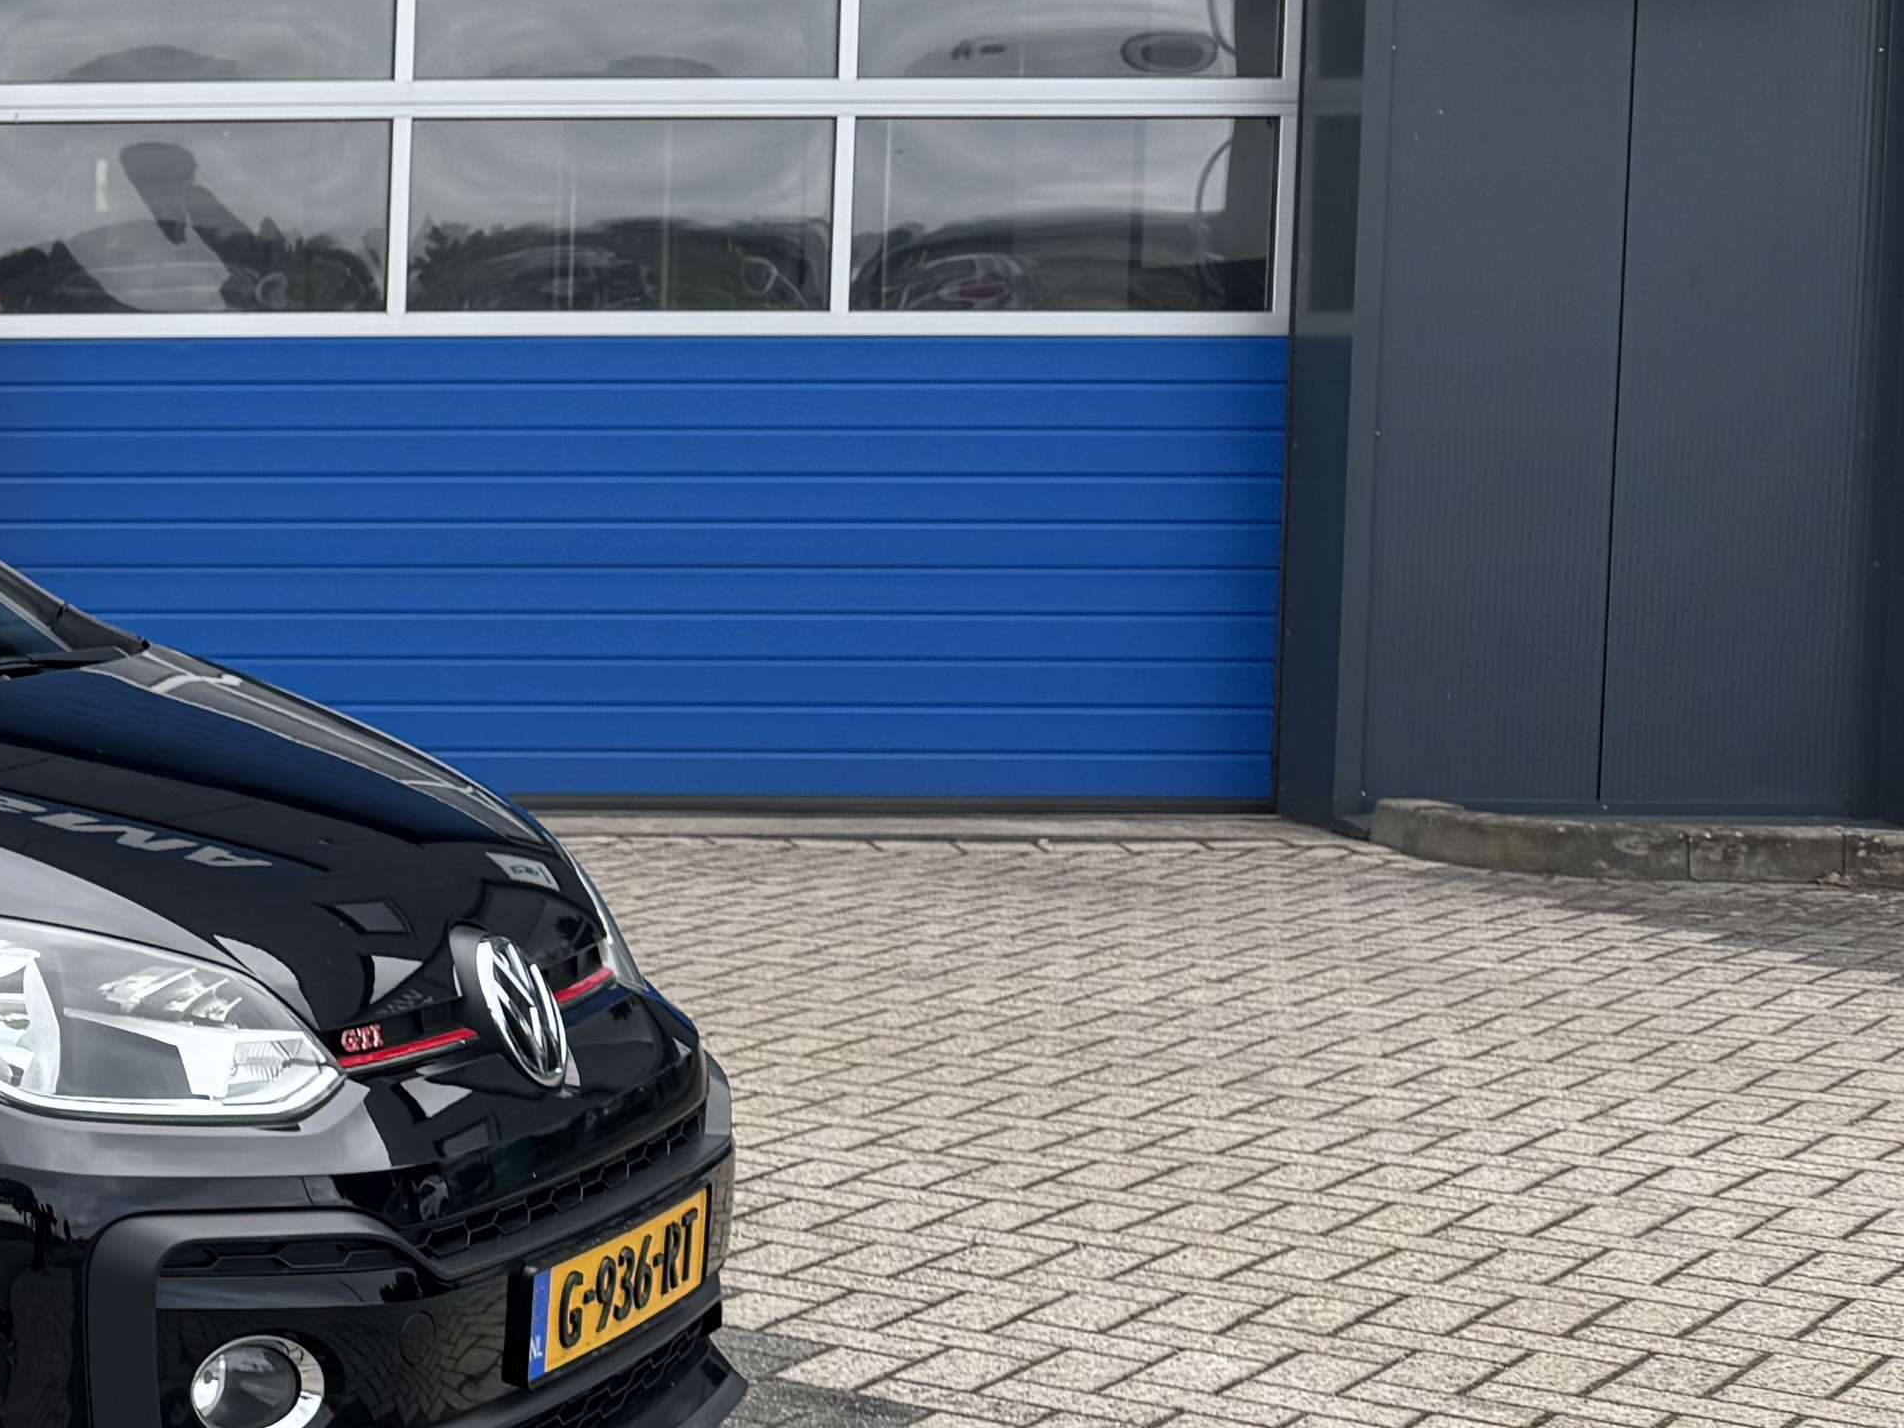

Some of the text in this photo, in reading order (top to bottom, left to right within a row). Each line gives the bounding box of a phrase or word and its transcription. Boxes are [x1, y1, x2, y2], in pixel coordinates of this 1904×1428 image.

[341, 1024, 384, 1052] GTI
[559, 1207, 698, 1350] G-936-RT
[529, 1335, 543, 1358] NL
